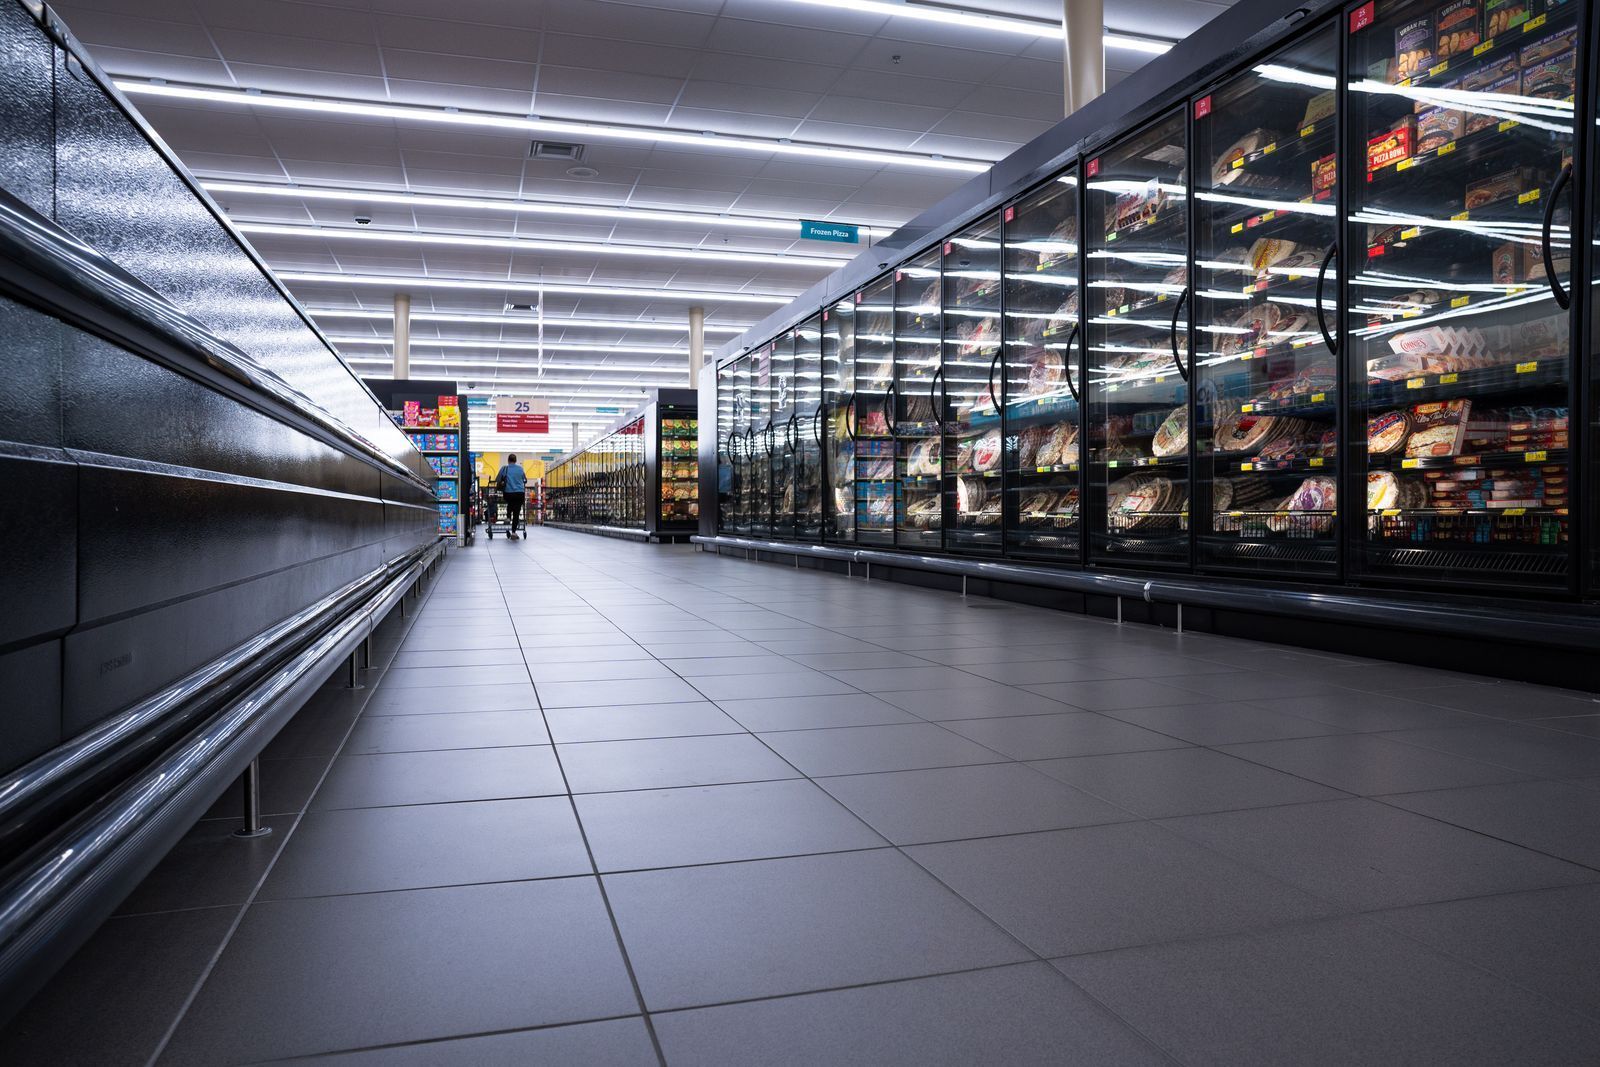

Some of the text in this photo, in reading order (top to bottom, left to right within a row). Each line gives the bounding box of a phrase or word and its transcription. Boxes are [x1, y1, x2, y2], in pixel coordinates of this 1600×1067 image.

[1400, 22, 1417, 36] URBAN
[1373, 146, 1405, 165] PIZZA BOWL
[810, 228, 848, 238] Frozen Pizza
[515, 401, 530, 412] 25
